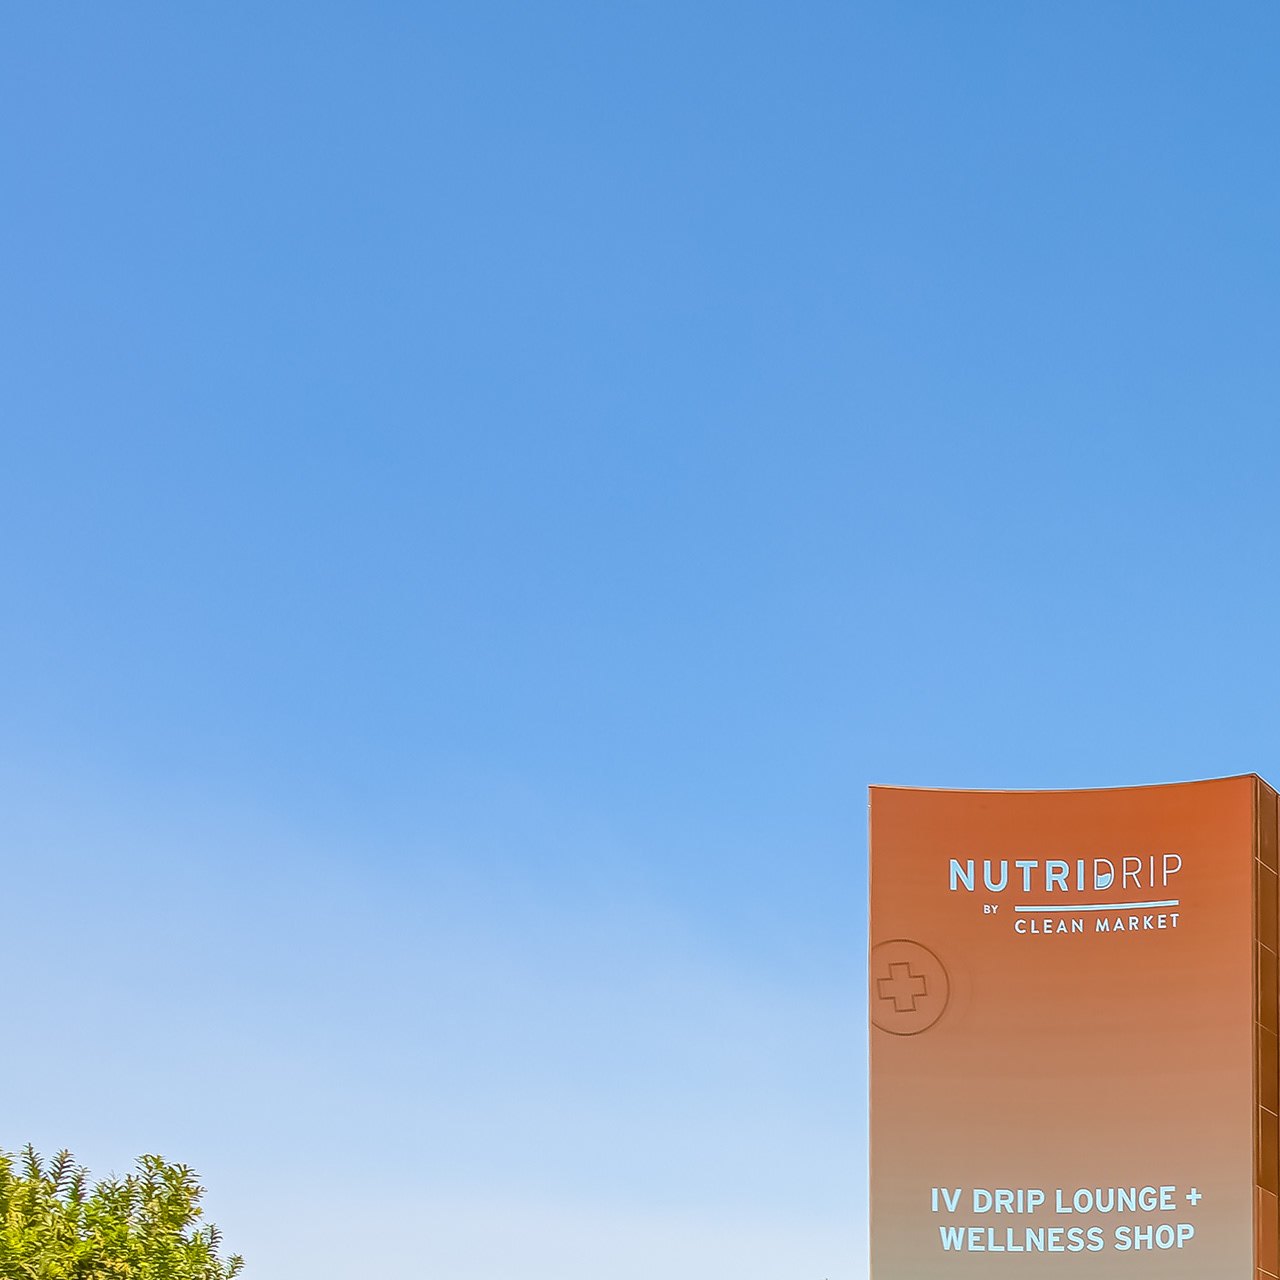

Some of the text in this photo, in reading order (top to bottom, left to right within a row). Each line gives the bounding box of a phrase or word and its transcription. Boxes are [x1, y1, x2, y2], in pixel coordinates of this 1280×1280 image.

[949, 853, 1184, 893] NUTRIDRIP
[983, 904, 999, 914] BY
[1014, 912, 1180, 934] CLEAN MARKET
[931, 1187, 962, 1213] IV
[972, 1188, 1046, 1214] DRIP
[1055, 1186, 1177, 1214] LOUNGE
[939, 1223, 1195, 1252] WELLNESS SHOP
